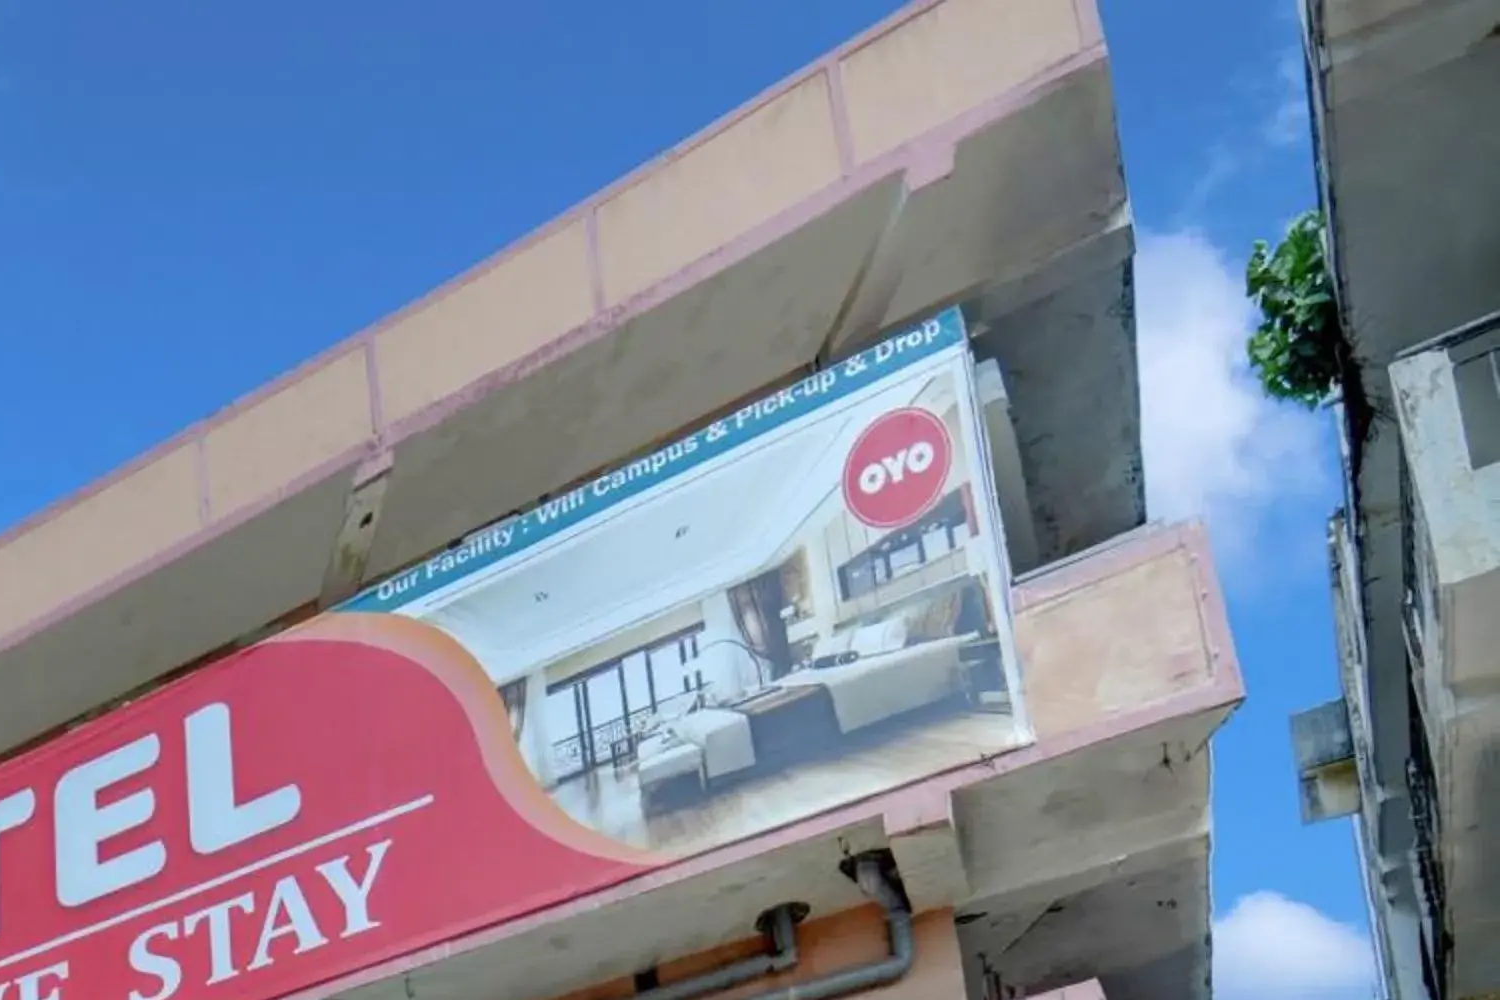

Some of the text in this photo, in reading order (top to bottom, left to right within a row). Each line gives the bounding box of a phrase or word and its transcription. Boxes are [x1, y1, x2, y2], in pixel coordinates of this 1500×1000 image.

[377, 572, 419, 600] Our
[426, 524, 515, 579] Facility
[592, 434, 698, 498] Campus
[705, 418, 729, 442] &
[735, 369, 836, 428] Pick-up
[845, 355, 869, 377] &
[874, 319, 941, 363] Drop
[858, 441, 934, 494] OYO
